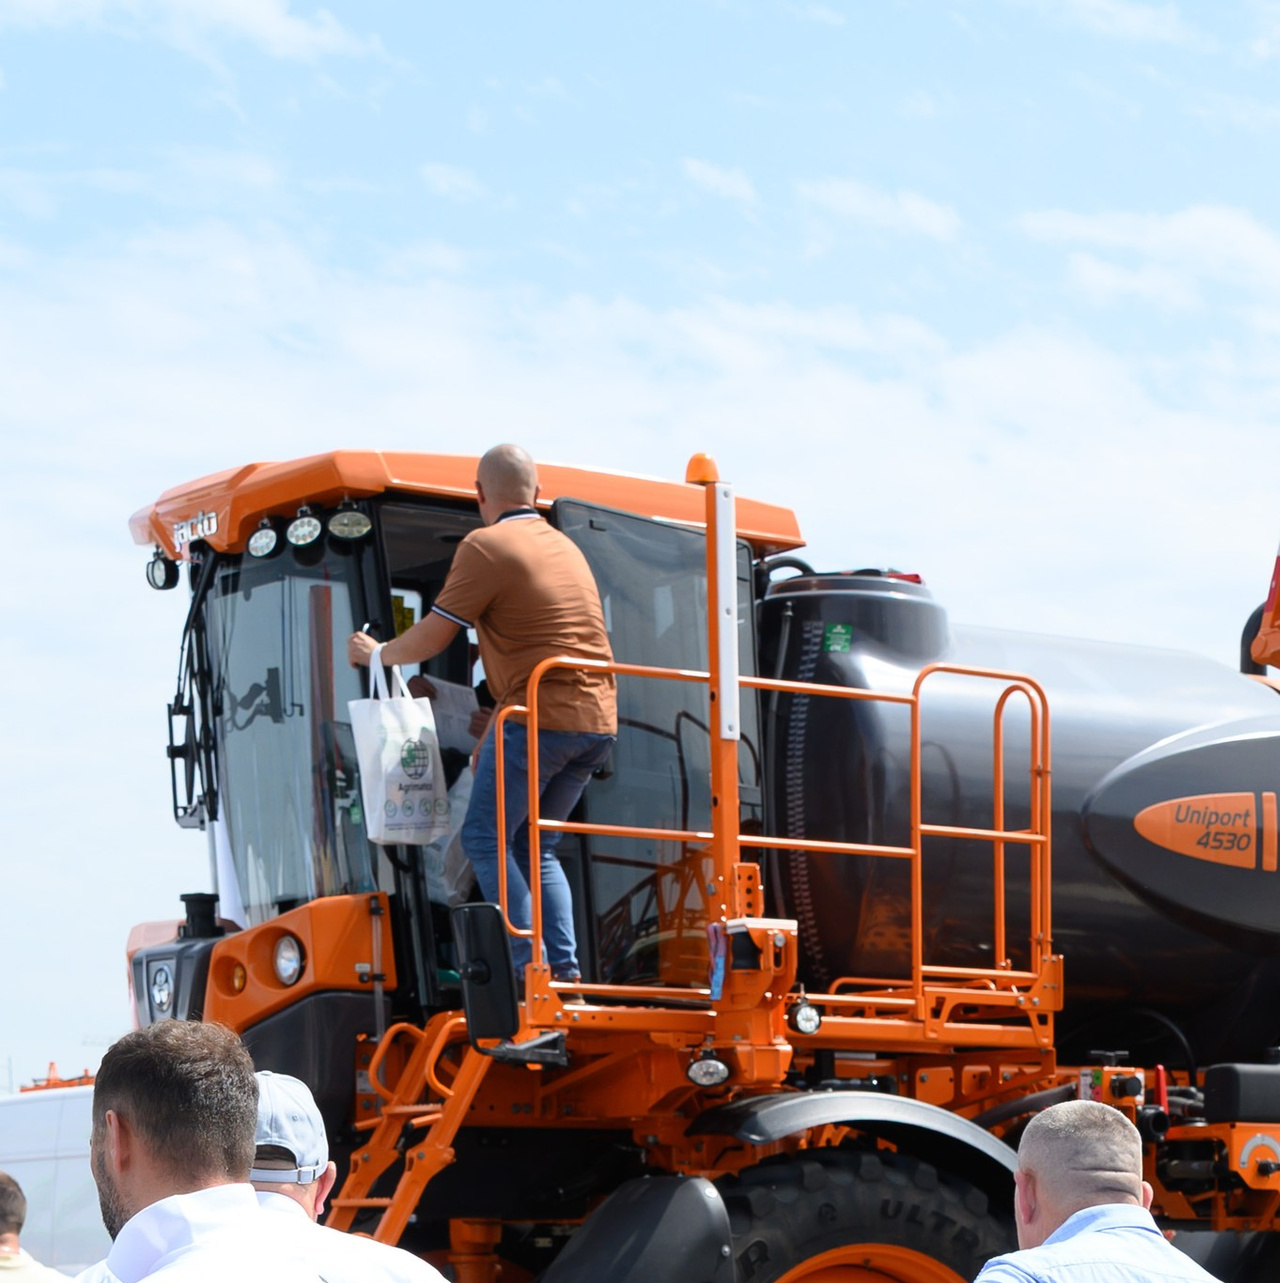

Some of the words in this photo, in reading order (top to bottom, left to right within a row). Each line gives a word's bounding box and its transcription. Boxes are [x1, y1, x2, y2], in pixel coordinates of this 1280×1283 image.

[173, 510, 218, 552] jacto
[1174, 804, 1251, 829] Uniport
[1196, 831, 1251, 851] 4530
